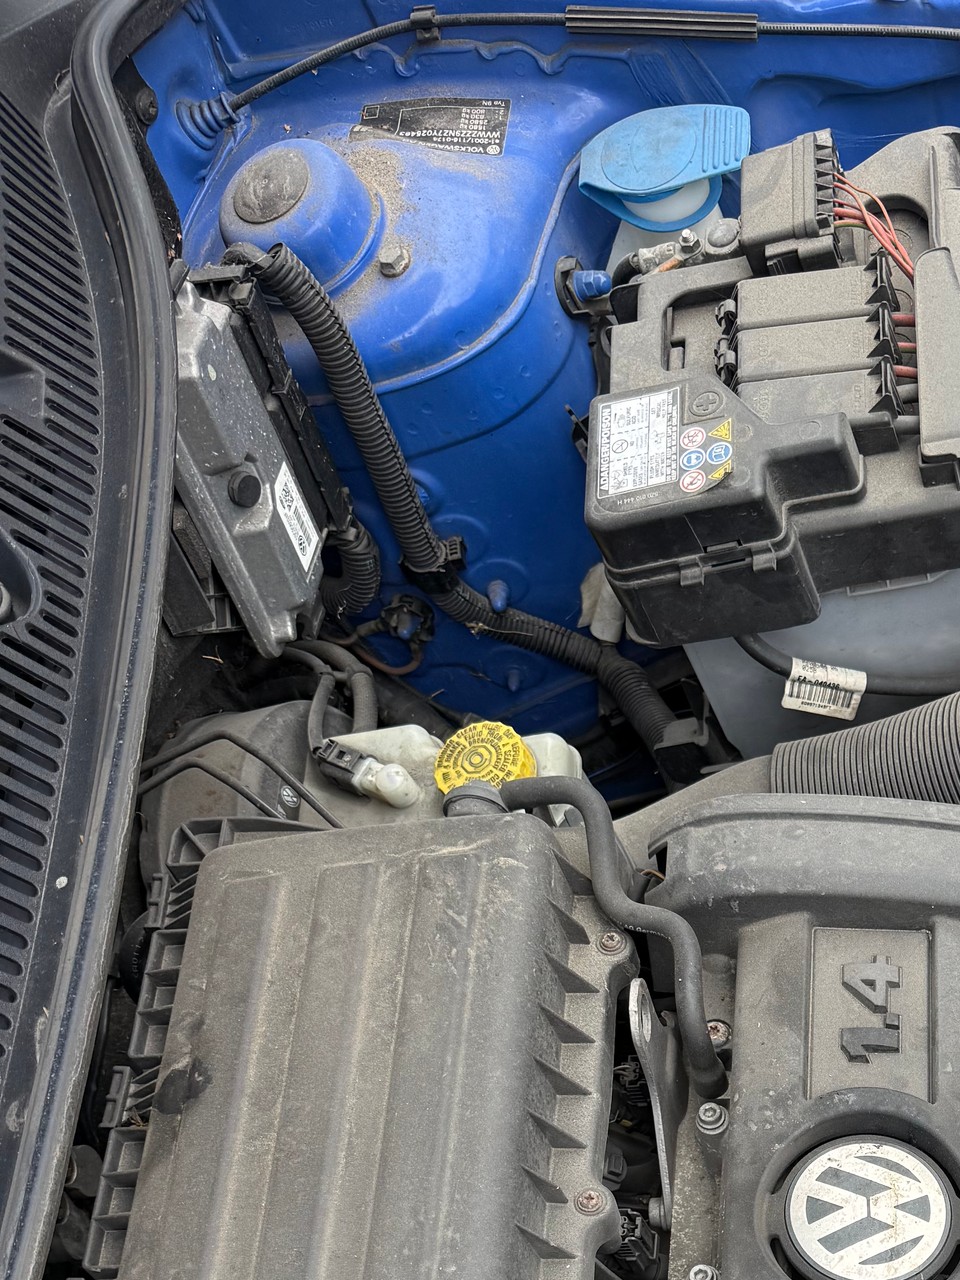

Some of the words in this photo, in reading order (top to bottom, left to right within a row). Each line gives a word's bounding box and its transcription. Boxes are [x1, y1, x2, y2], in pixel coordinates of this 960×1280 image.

[599, 408, 611, 484] DANGER/POISON
[457, 726, 477, 738] CLEAN
[464, 731, 483, 741] FLUID
[487, 730, 503, 742] FROM
[499, 750, 511, 772] SEALED
[841, 954, 904, 1063] 1.4
